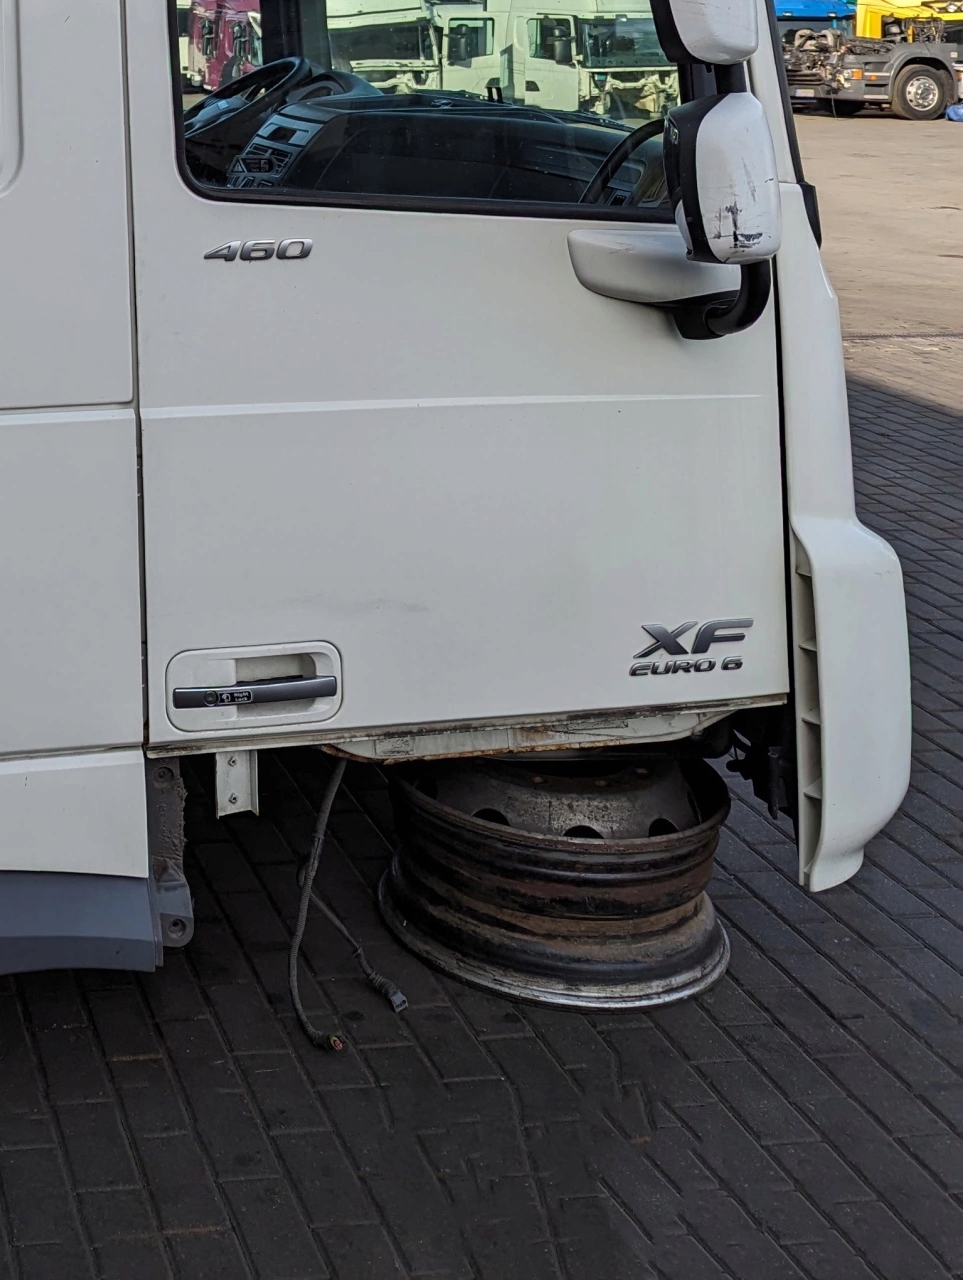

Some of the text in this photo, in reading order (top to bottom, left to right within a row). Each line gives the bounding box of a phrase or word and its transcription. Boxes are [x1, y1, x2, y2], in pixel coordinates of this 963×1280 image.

[203, 238, 313, 261] 460
[633, 618, 754, 658] XF
[629, 656, 743, 676] EURO 6
